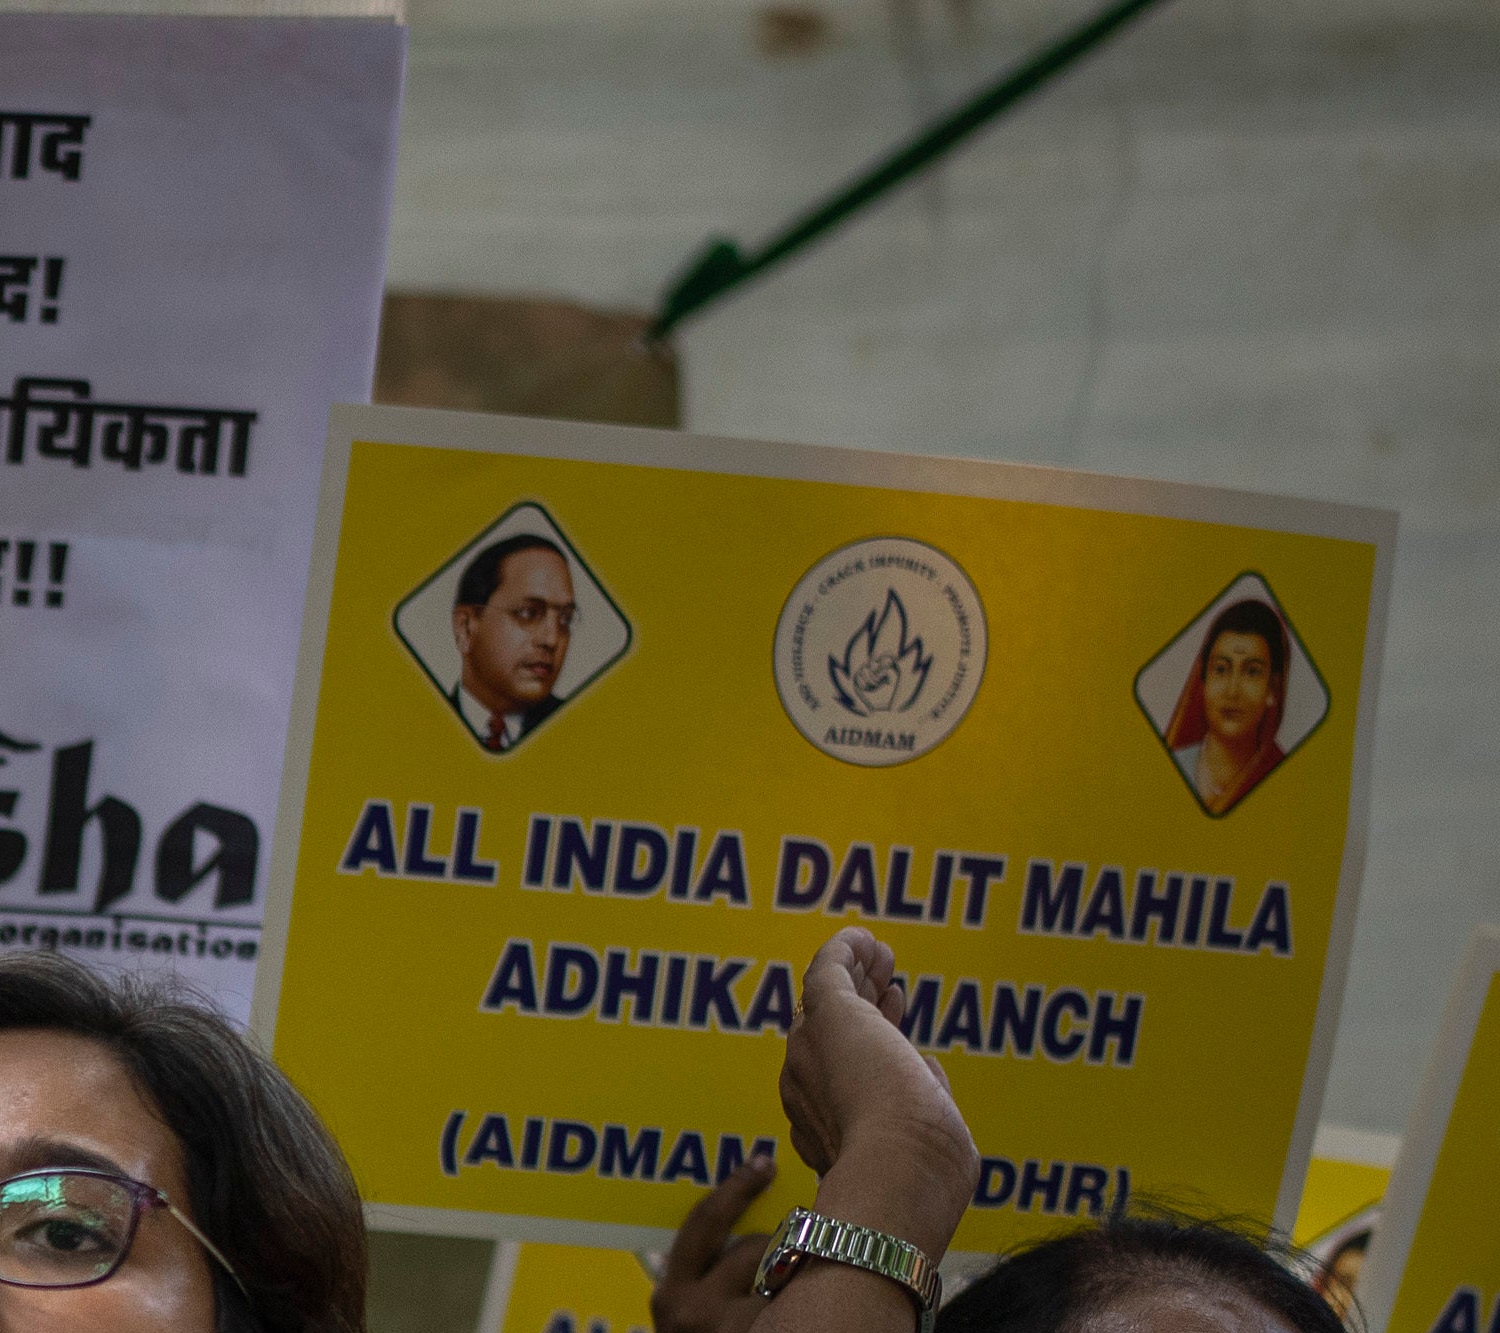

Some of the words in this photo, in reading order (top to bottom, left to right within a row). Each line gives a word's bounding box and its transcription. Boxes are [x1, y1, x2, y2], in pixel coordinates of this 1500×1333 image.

[824, 726, 916, 750] AIDMAM
[345, 803, 496, 880] ALL
[524, 816, 749, 905] INDIA
[777, 840, 1003, 924] DALIT
[1022, 861, 1295, 953] MAHILA
[485, 942, 797, 1031] ADHIKA
[892, 977, 1141, 1066] MANCH
[440, 1113, 776, 1187] (AIDMAM
